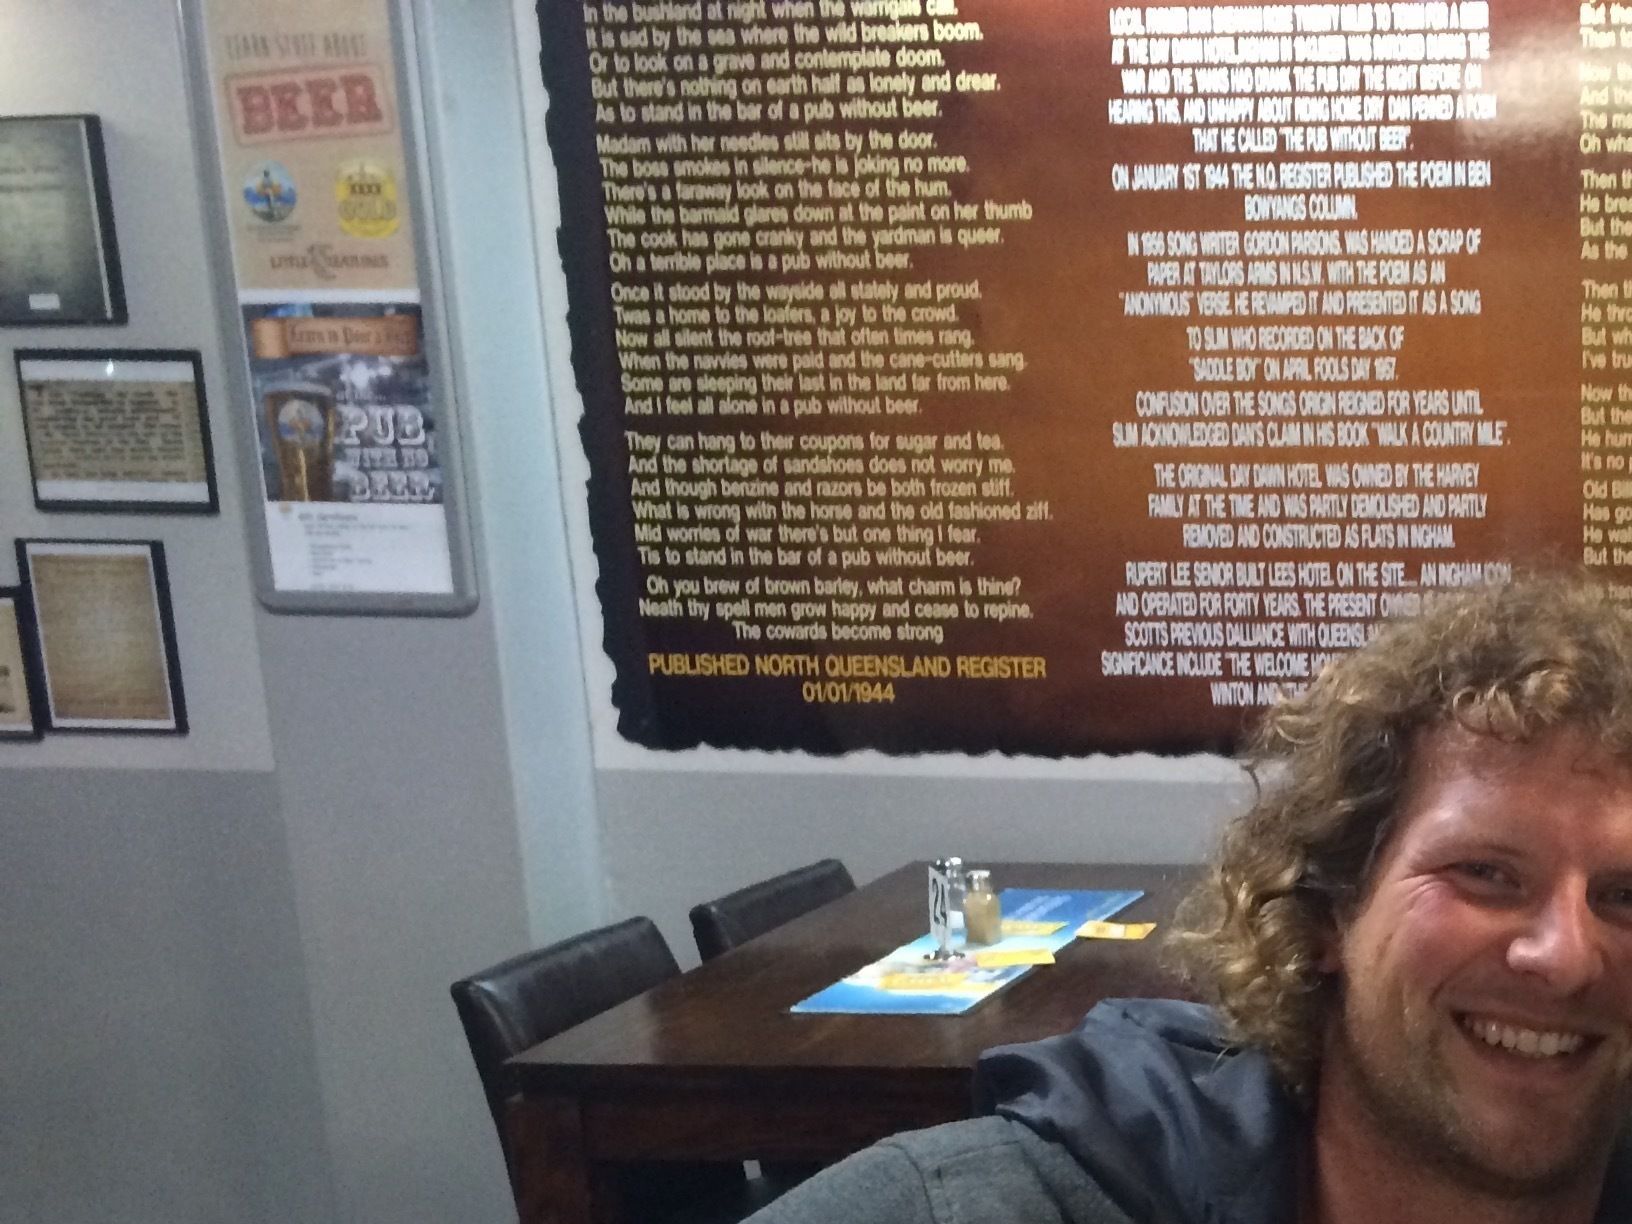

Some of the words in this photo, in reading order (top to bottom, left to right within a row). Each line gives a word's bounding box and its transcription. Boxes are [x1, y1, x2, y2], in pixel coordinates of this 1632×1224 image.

[237, 74, 383, 135] BEER
[1192, 127, 1218, 152] THAT
[1220, 127, 1235, 152] HE
[1237, 126, 1277, 152] CALLED
[1306, 126, 1327, 151] PUB
[1329, 125, 1376, 151] WITHOUT
[609, 254, 631, 271] Oh
[636, 257, 645, 271] a
[649, 253, 701, 271] terrible
[705, 252, 745, 274] place
[749, 252, 762, 270] is
[767, 255, 777, 269] a
[781, 252, 810, 274] pub
[815, 251, 870, 269] without
[655, 310, 665, 324] a
[668, 306, 710, 323] home
[714, 306, 730, 323] to
[734, 305, 758, 323] the
[820, 308, 829, 322] a
[835, 305, 856, 327] joy
[861, 304, 877, 322] to
[881, 304, 906, 322] the
[1580, 304, 1601, 322] He
[1135, 391, 1199, 416] CONFUSION
[1201, 390, 1230, 416] OVER
[1233, 390, 1255, 416] THE
[1298, 390, 1336, 415] ORIGIN
[1338, 390, 1385, 415] REIGNED
[1387, 390, 1410, 415] FOR
[1412, 390, 1449, 414] YEARS
[337, 404, 426, 445] PUB
[626, 432, 661, 454] They
[666, 436, 694, 450] can
[697, 432, 735, 454] hang
[739, 432, 755, 450] to
[760, 432, 793, 450] their
[799, 436, 864, 454] coupons
[869, 432, 889, 449] for
[895, 435, 937, 454] sugar
[943, 432, 971, 449] and
[976, 432, 1005, 449] tea.
[351, 470, 435, 501] BEER
[630, 478, 660, 496] And
[664, 478, 717, 500] though
[720, 478, 778, 496] benzine
[784, 479, 811, 496] and
[816, 482, 862, 496] razors
[866, 479, 886, 496] be
[890, 479, 925, 496] both
[929, 479, 976, 496] frozen
[1582, 481, 1607, 499] Old
[1147, 493, 1183, 517] FAMILY
[1187, 493, 1200, 517] AT
[1204, 493, 1225, 517] THE
[1228, 493, 1254, 517] TIME
[1257, 493, 1280, 517] AND
[1282, 493, 1307, 517] WAS
[1309, 493, 1347, 517] PARTLY
[1350, 493, 1419, 517] DEMOLISHED
[1422, 493, 1445, 517] AND
[1448, 493, 1487, 517] PARTLY
[1182, 523, 1234, 547] REMOVED
[1237, 523, 1260, 548] AND
[1262, 523, 1341, 548] CONSTRUCTED
[1344, 523, 1359, 548] AS
[1361, 523, 1394, 548] FLATS
[1396, 523, 1408, 548] IN
[1582, 525, 1602, 542] He
[734, 621, 760, 638] The
[765, 621, 827, 639] cowards
[831, 622, 891, 639] become
[896, 622, 943, 644] strong
[648, 653, 749, 675] PUBLISHED
[754, 654, 819, 676] NORTH
[824, 655, 951, 677] QUEENSLAND
[956, 656, 1046, 678] REGISTER
[802, 682, 895, 702] 01/01/1944
[932, 878, 947, 927] 24
